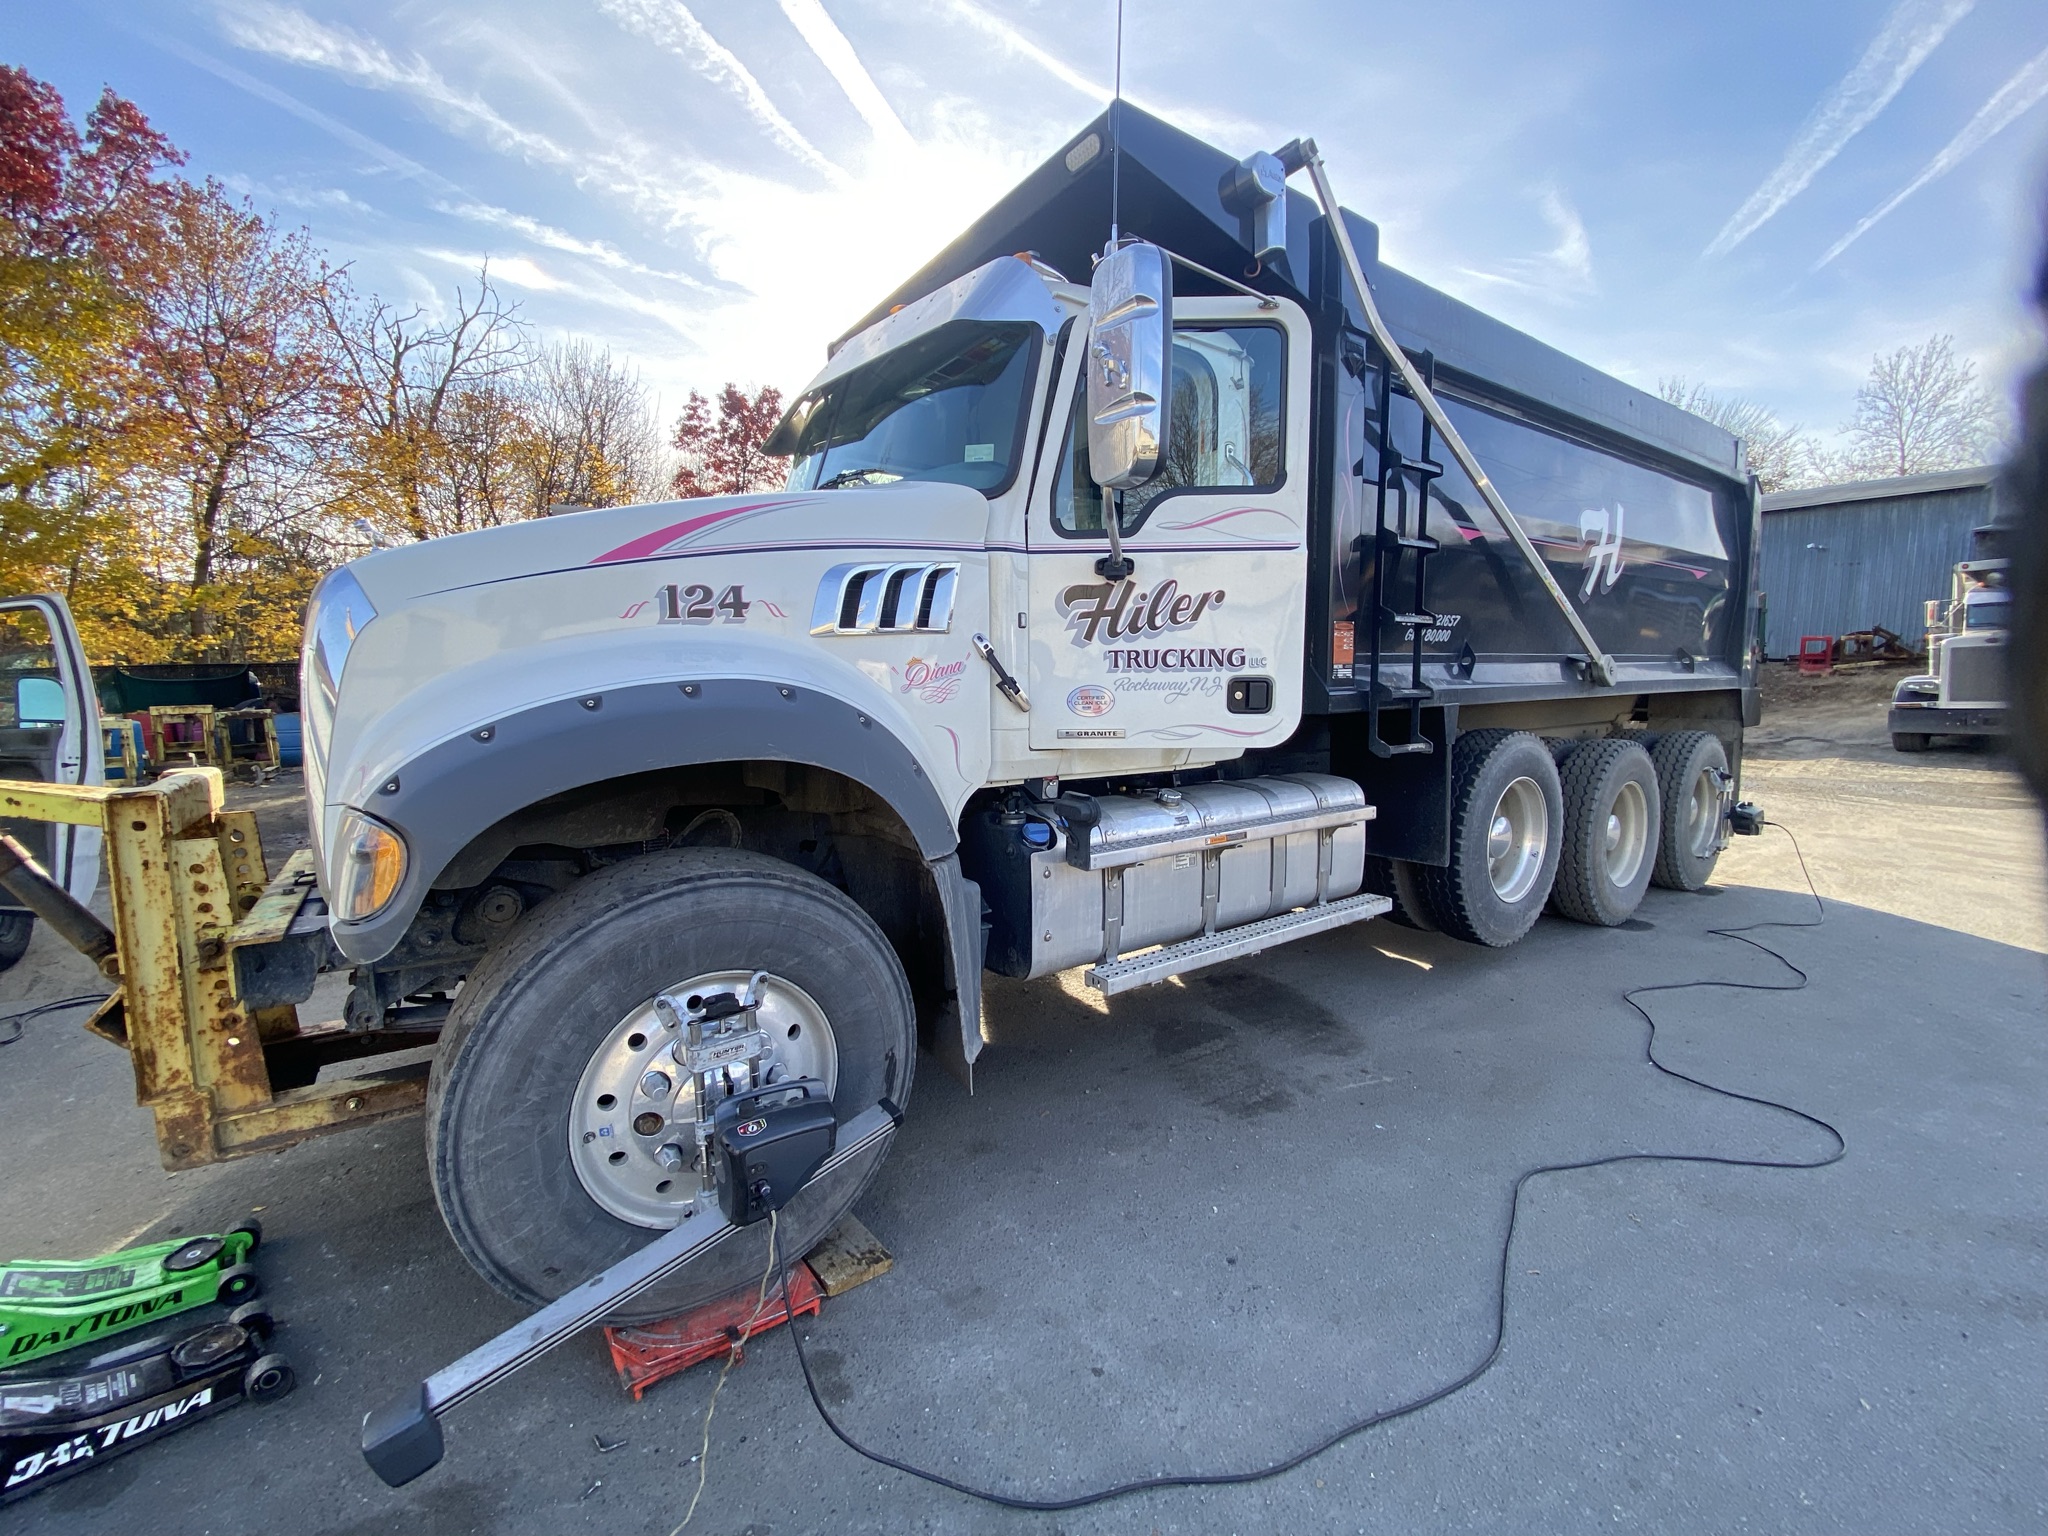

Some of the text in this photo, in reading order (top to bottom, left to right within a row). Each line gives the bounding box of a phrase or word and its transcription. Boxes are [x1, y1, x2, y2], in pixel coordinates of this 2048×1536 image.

[655, 583, 752, 624] 124
[1056, 578, 1226, 647] Hiler
[1424, 628, 1452, 645] 80,000
[1104, 648, 1267, 673] TRUCKING LLC
[8, 1289, 184, 1358] DAYTONA
